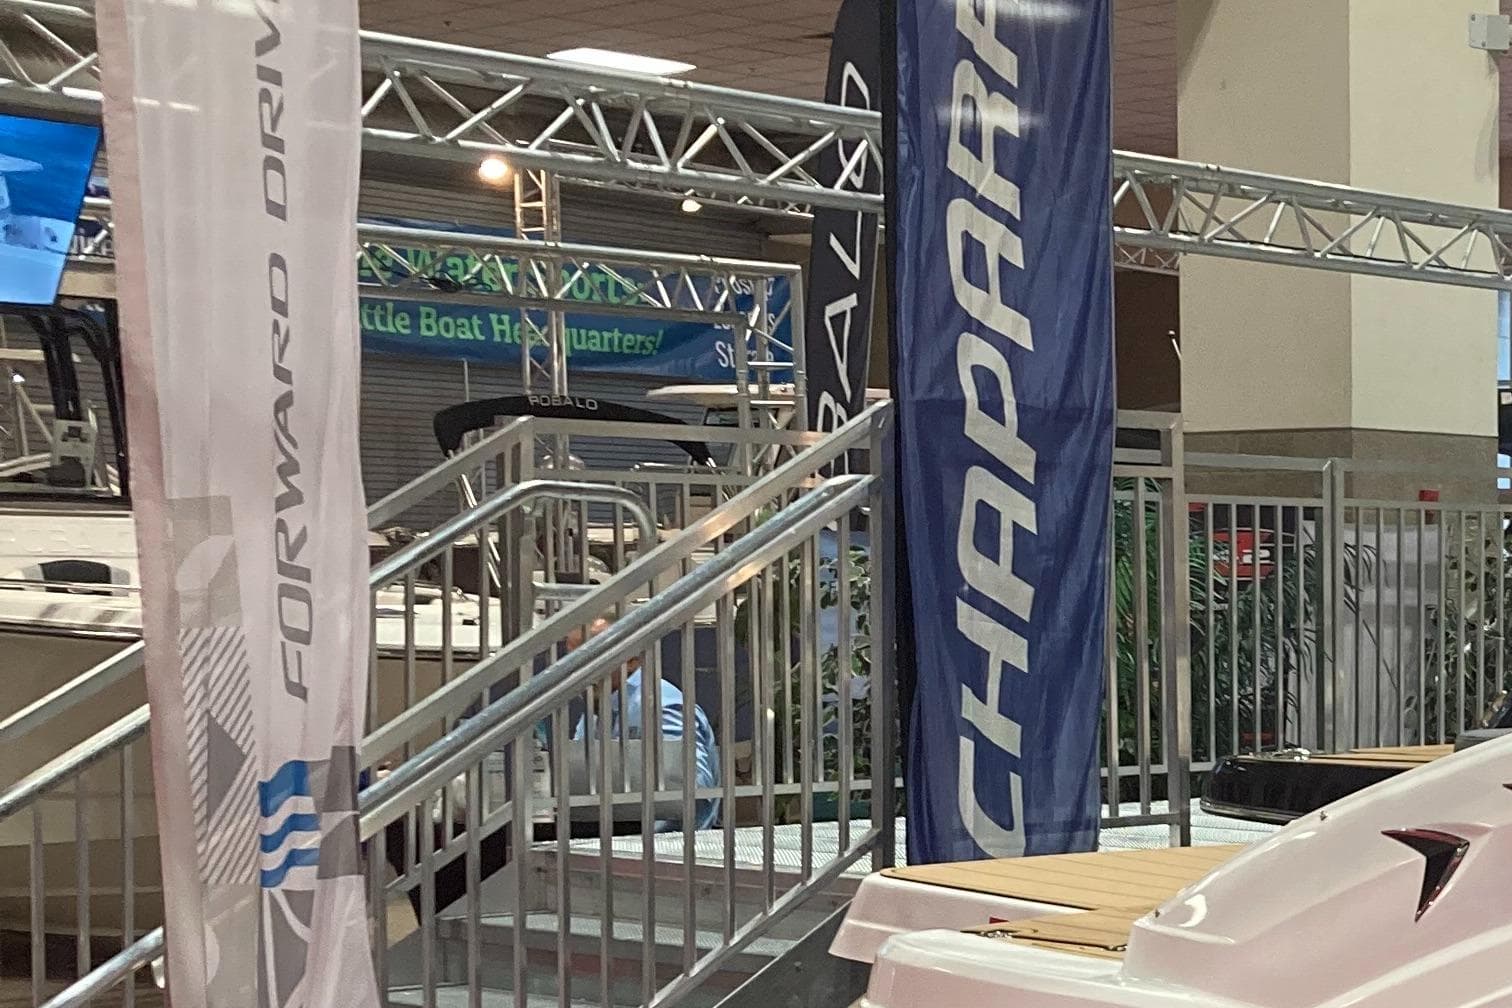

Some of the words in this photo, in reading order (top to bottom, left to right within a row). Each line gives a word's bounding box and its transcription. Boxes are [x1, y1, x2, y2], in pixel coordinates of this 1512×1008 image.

[254, 0, 287, 223] DRIV
[358, 301, 411, 335] ttle
[419, 306, 486, 341] Boat
[268, 252, 313, 704] FORWARD
